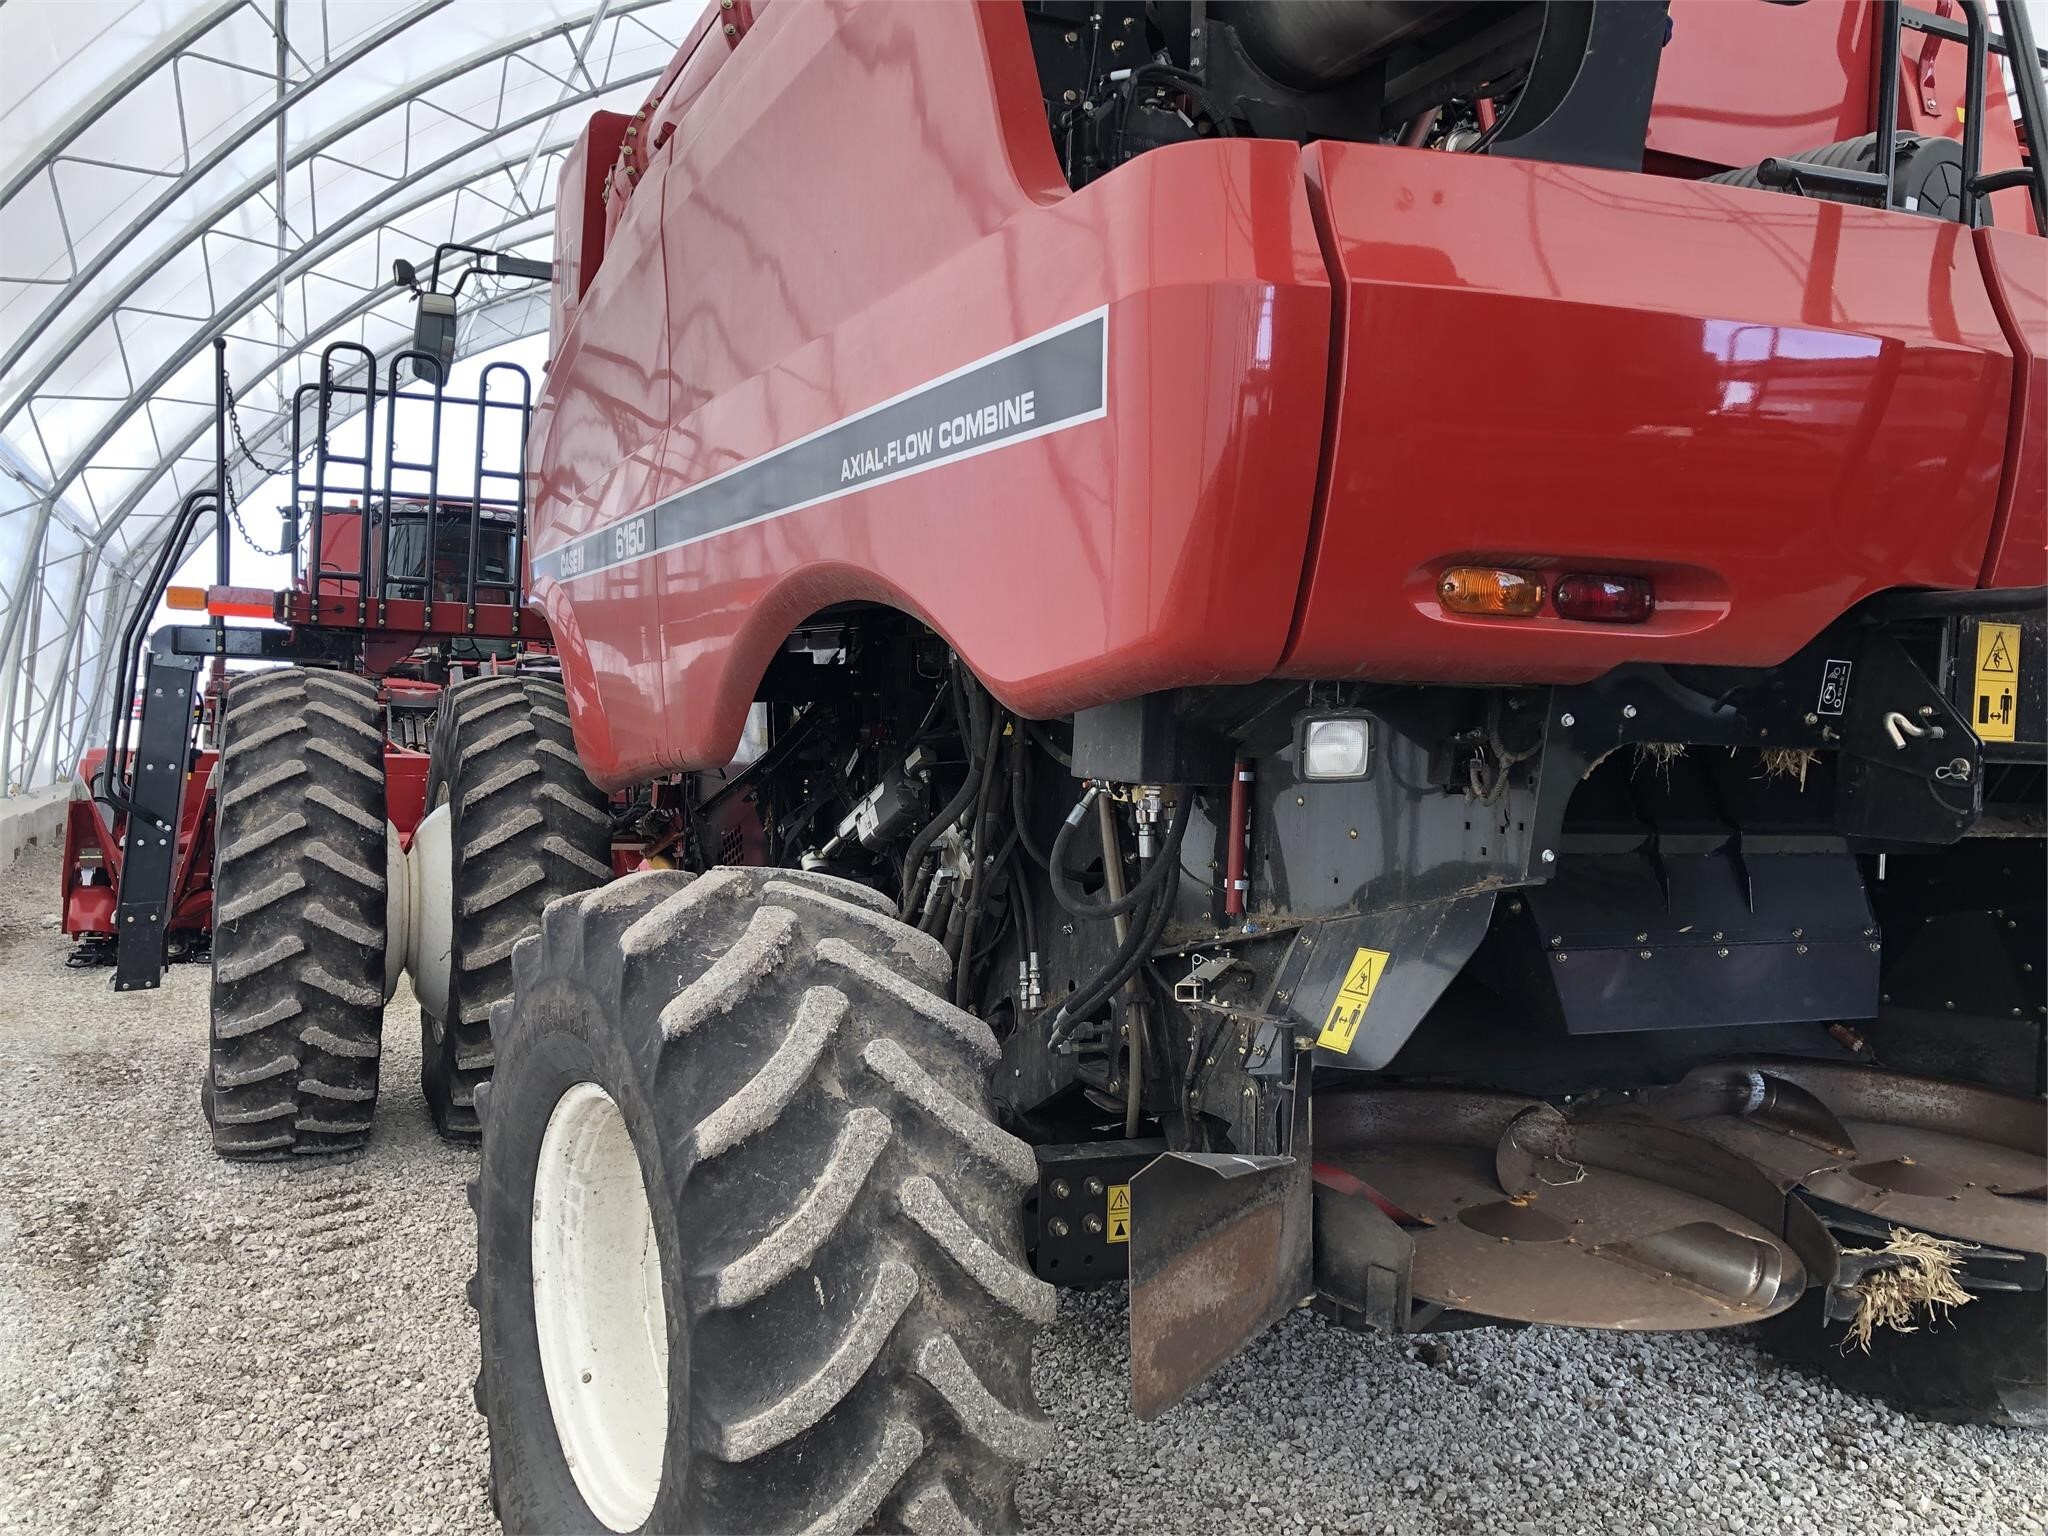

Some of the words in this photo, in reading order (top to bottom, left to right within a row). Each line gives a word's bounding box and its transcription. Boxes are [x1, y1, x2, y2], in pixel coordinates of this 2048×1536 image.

[841, 427, 933, 482] AXIAL-FLOW
[938, 390, 1035, 449] COMBINE
[615, 518, 646, 559] 6150
